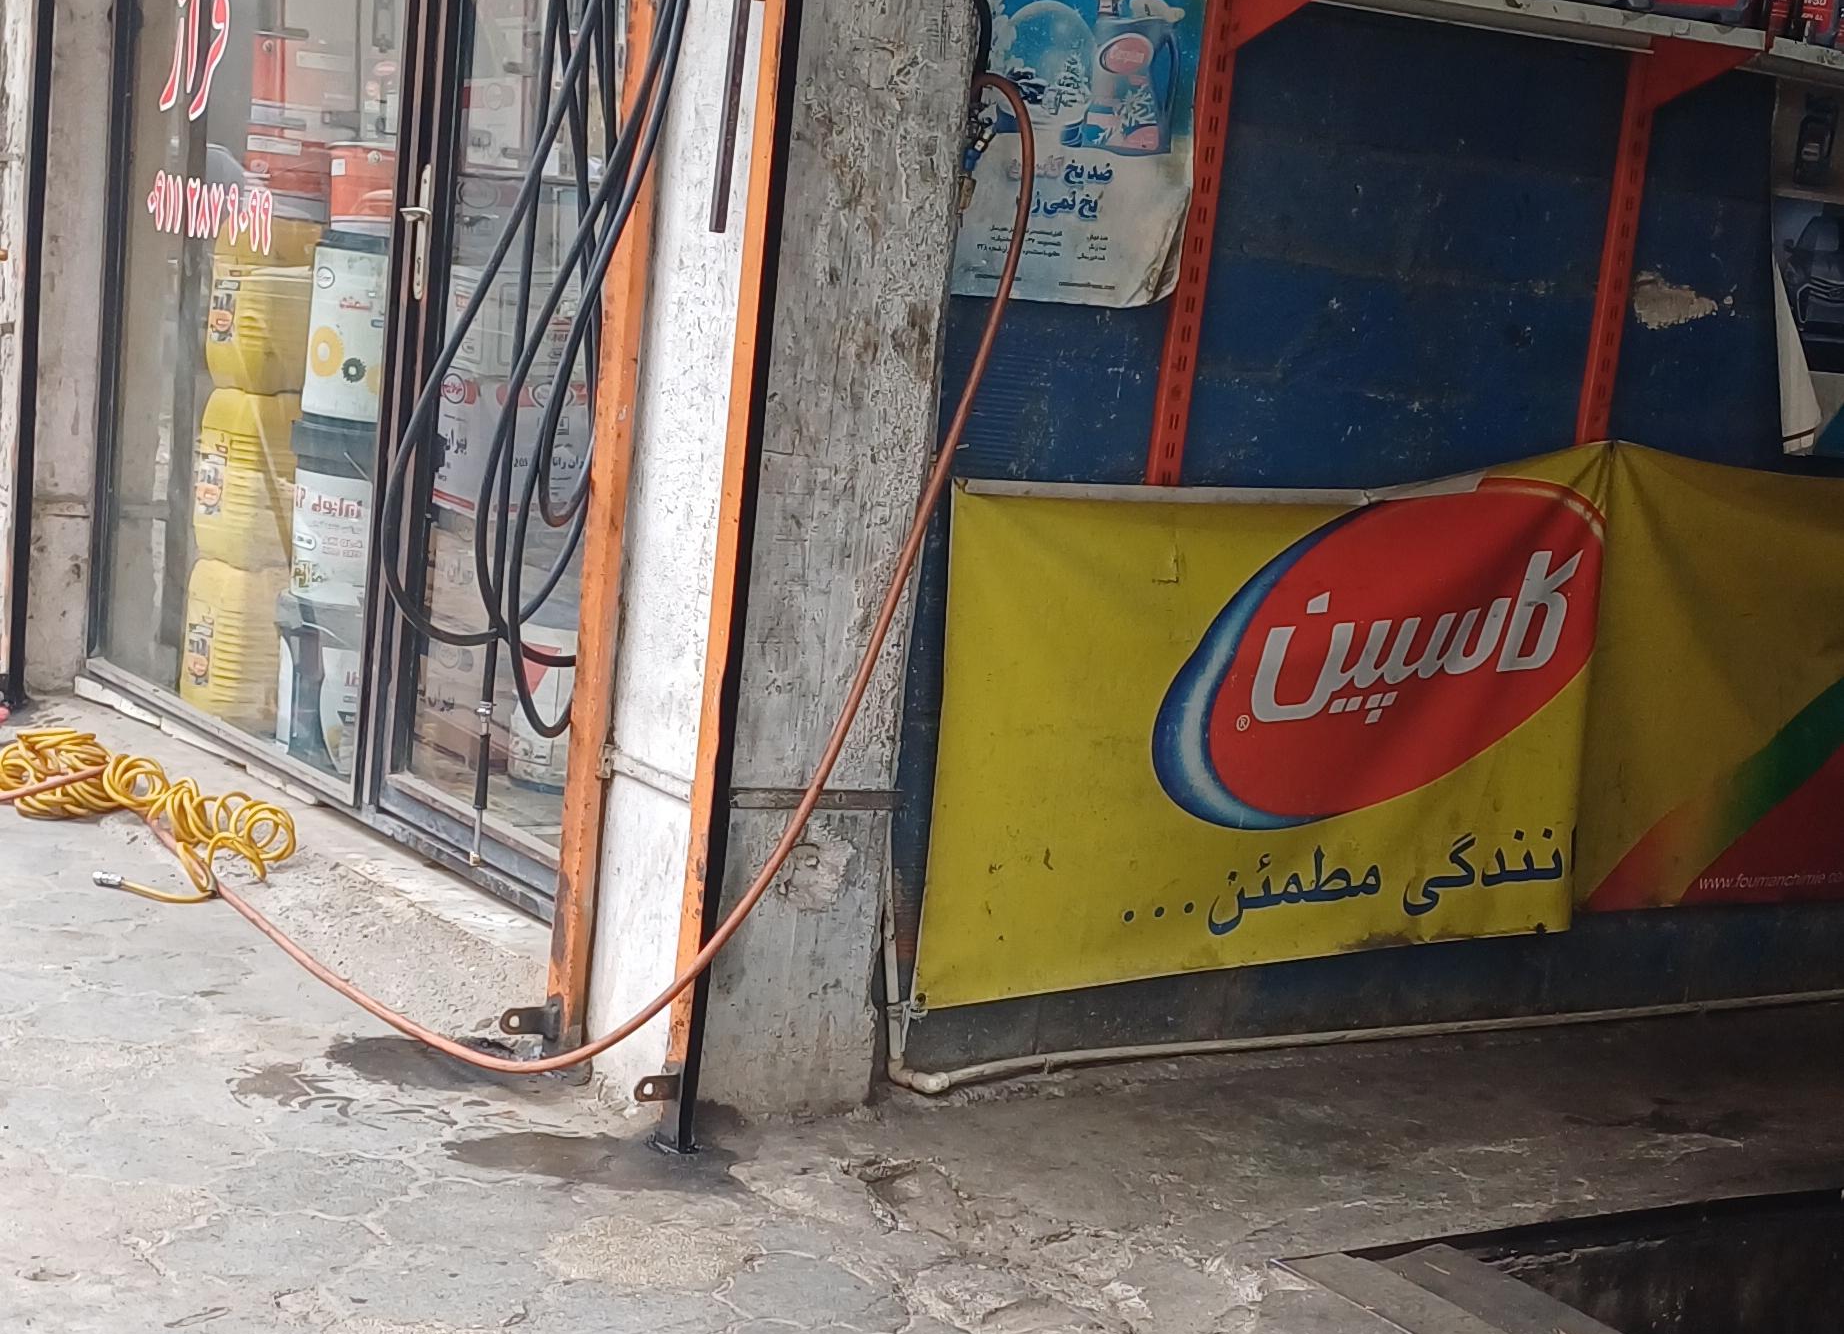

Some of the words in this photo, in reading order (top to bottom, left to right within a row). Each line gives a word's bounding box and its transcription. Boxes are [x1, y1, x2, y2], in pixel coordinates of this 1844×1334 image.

[1064, 159, 1084, 185] یخ
[1087, 162, 1113, 182] ضد
[1043, 190, 1077, 215] نمی
[1078, 193, 1098, 219] یخ
[1251, 549, 1583, 724] کاسپین
